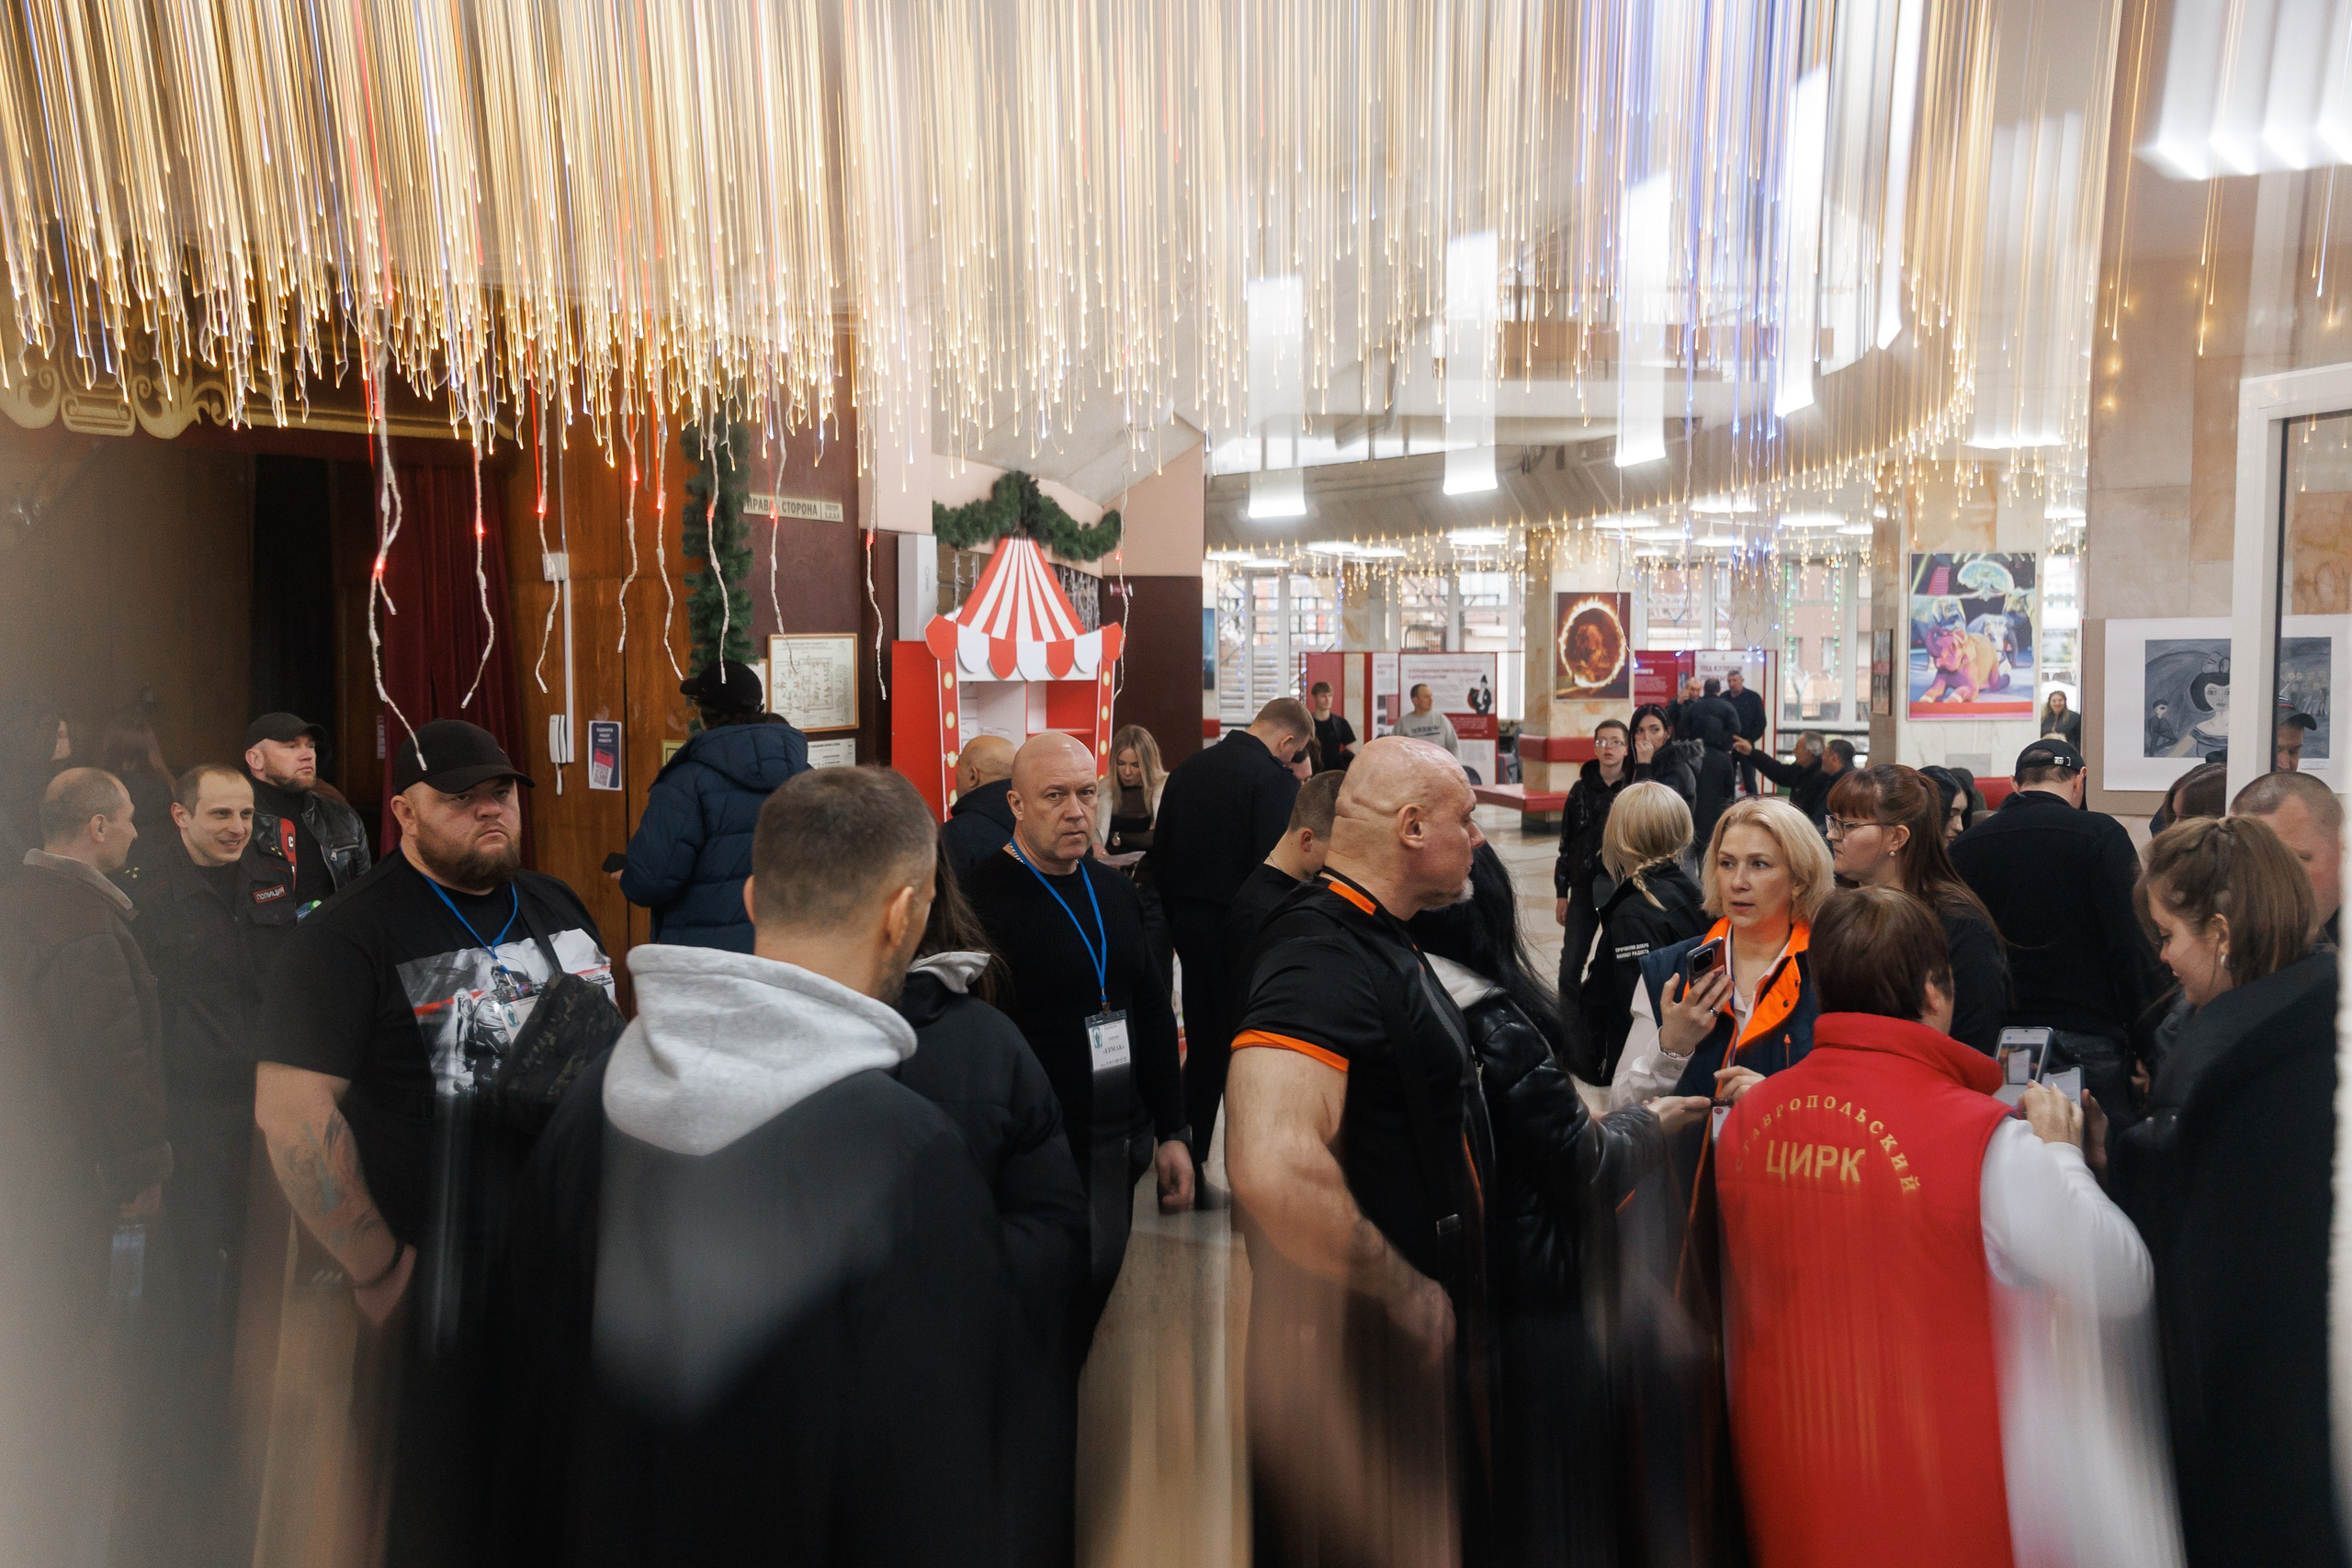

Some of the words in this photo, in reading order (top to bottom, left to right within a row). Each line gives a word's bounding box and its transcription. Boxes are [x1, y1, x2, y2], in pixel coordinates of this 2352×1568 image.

[747, 498, 781, 512] ПРАВ
[782, 501, 818, 516] СТОРОНА
[1766, 1140, 1865, 1183] ЦИРК
